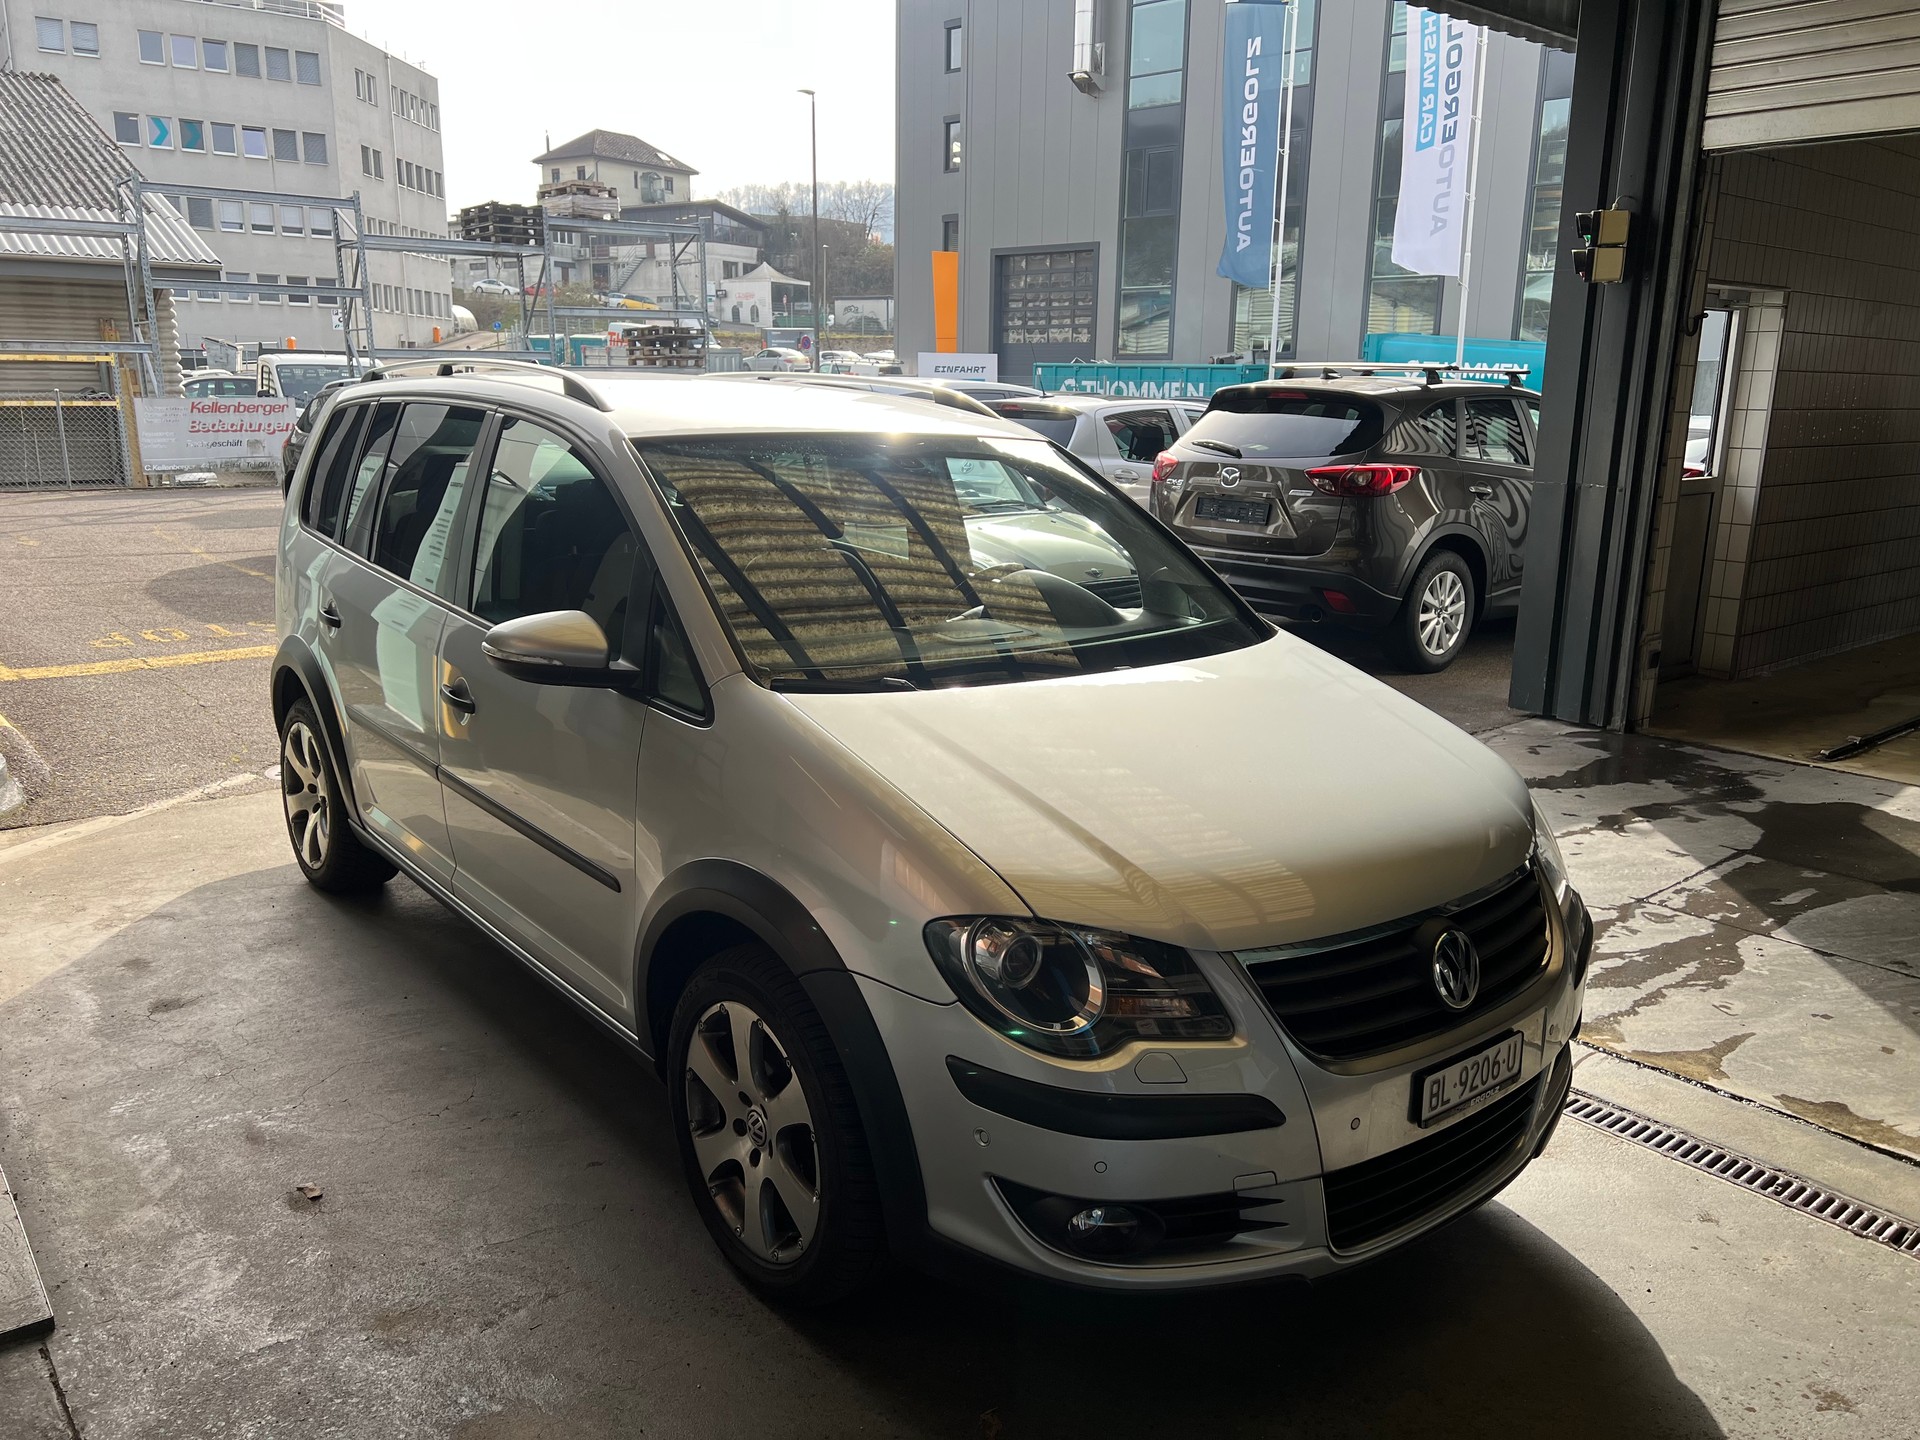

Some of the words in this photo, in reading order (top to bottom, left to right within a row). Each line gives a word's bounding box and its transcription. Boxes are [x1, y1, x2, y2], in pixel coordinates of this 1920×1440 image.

[934, 365, 986, 374] EINFAHRT
[190, 401, 289, 416] Kellenberger
[188, 418, 294, 435] Bedachungen
